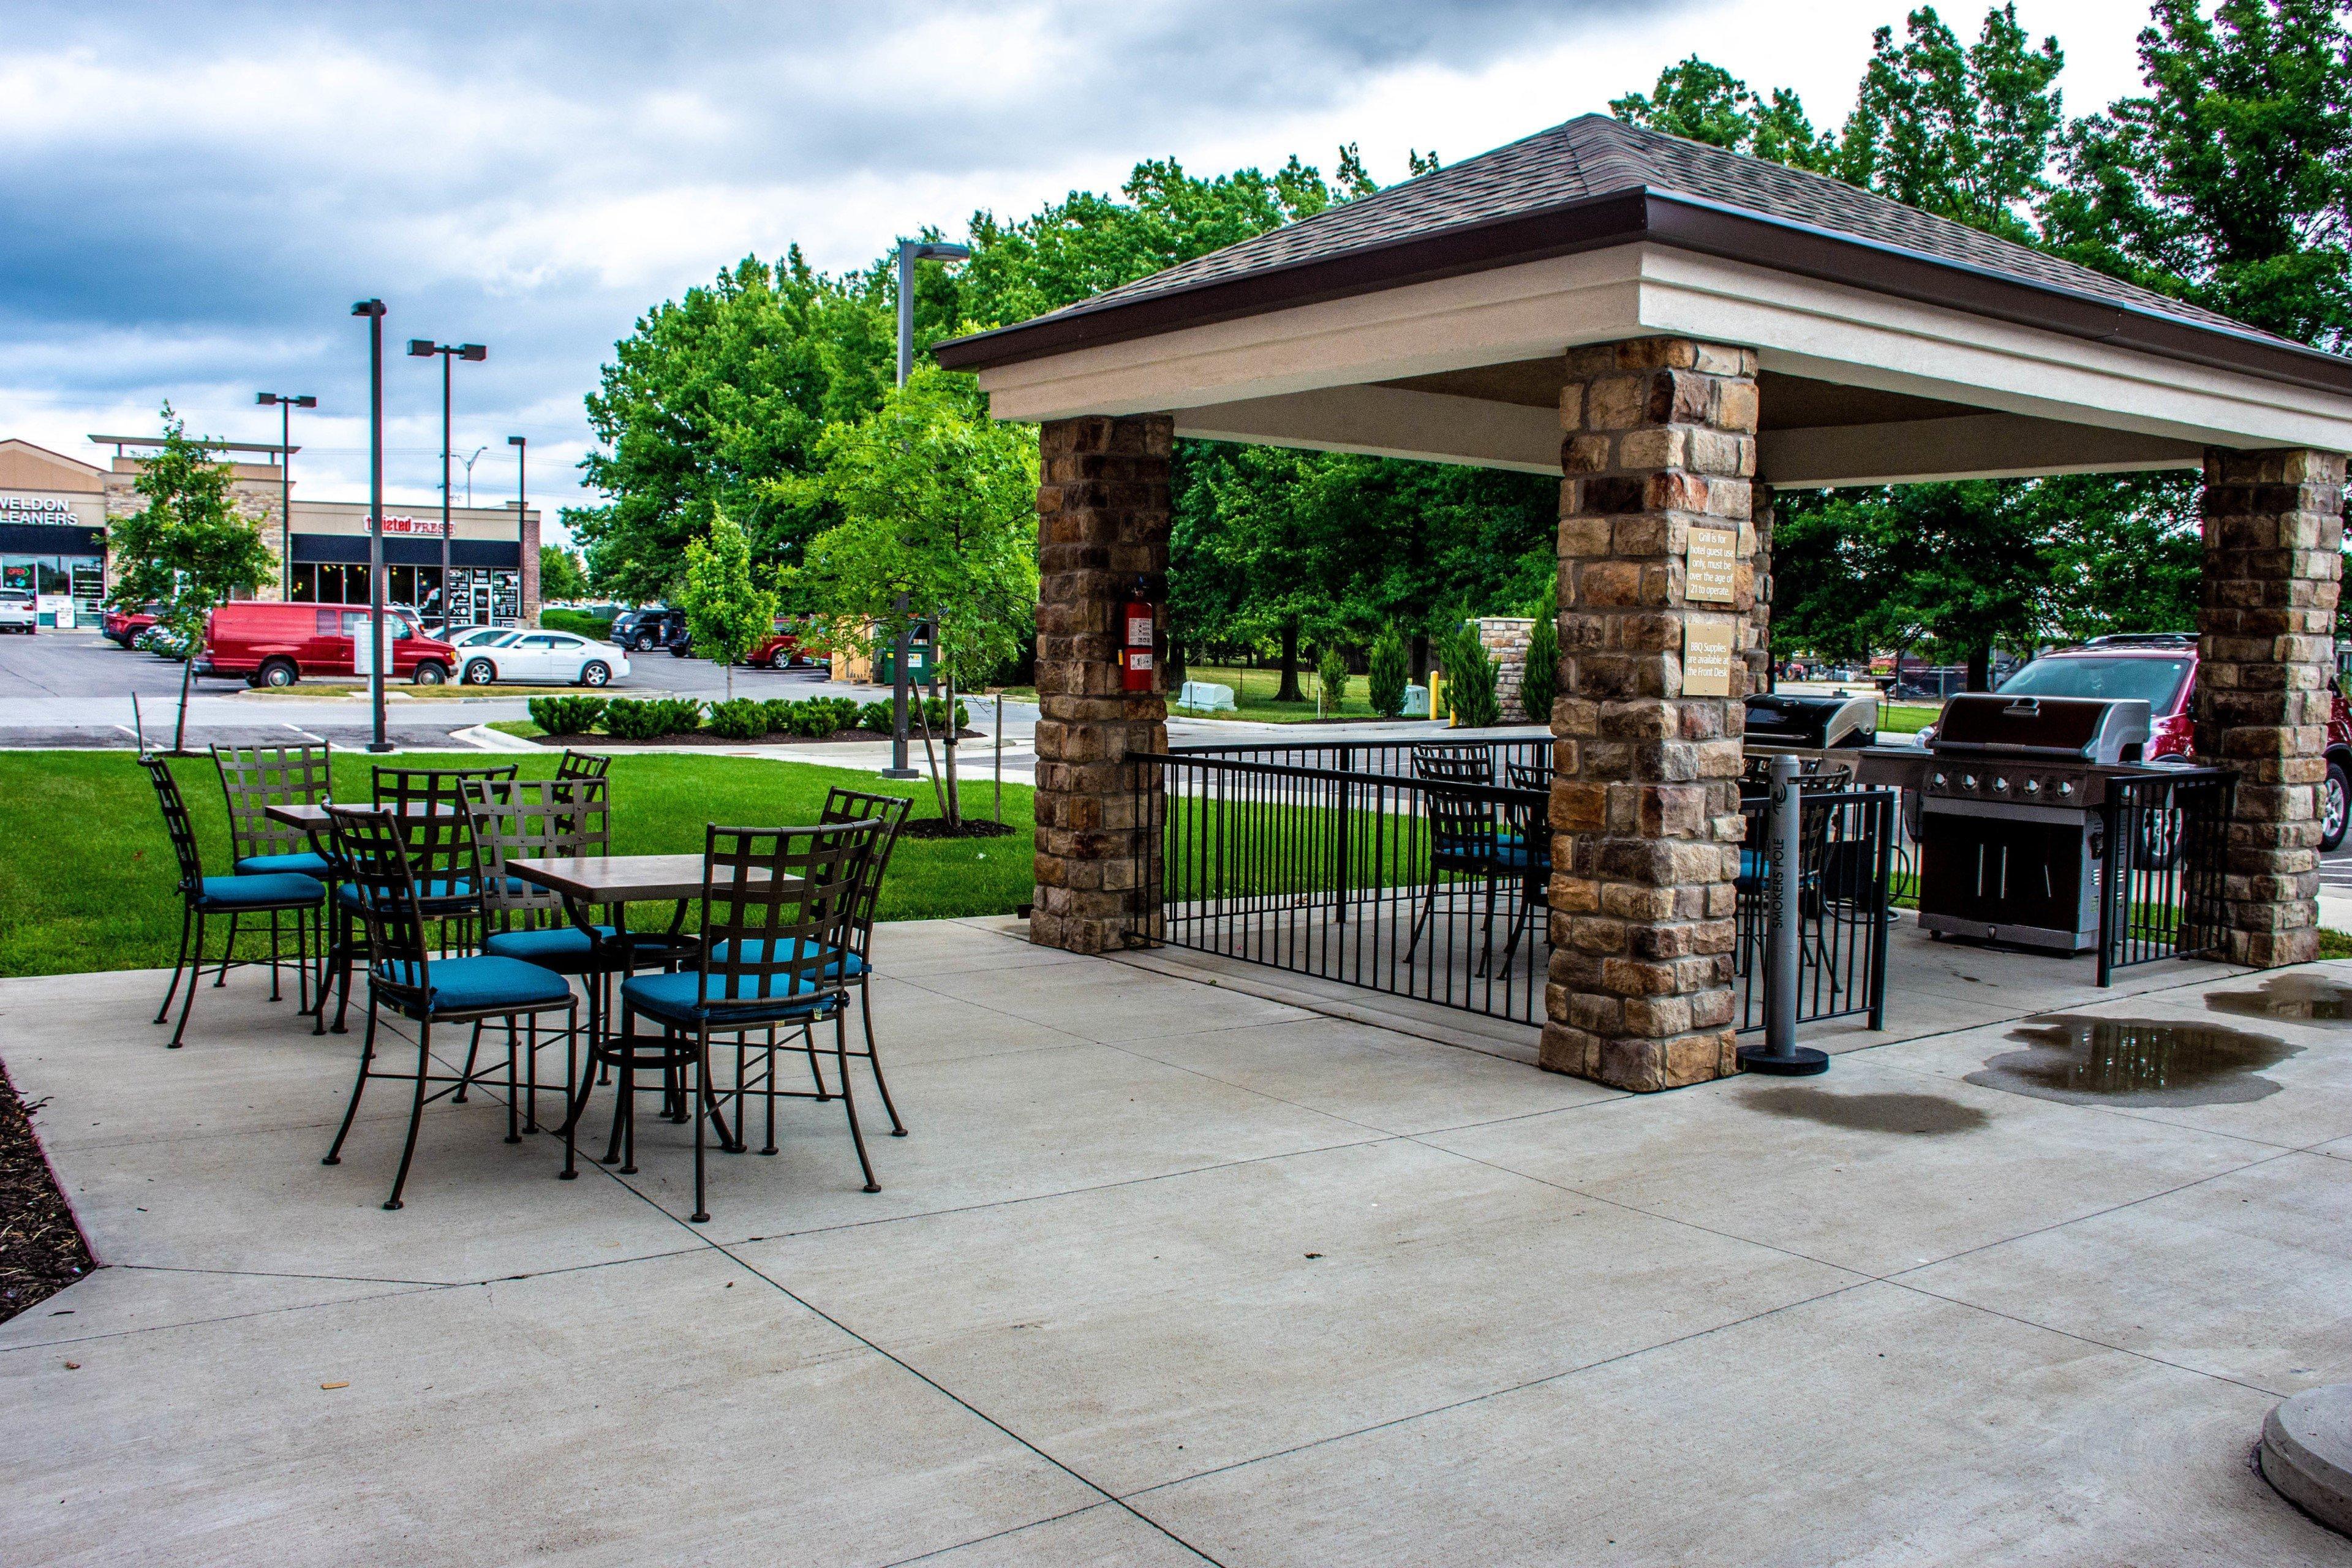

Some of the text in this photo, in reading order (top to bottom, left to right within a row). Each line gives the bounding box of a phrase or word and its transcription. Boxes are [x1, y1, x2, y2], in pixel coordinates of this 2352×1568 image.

[366, 516, 411, 532] tisted
[1698, 532, 1727, 544] Grill is for
[1691, 544, 1734, 558] hotel guest use
[1692, 558, 1732, 570] only, must be
[1703, 571, 1713, 581] the
[1714, 575, 1725, 584] age
[1727, 573, 1733, 583] of
[1691, 584, 1730, 598] 21 to operate.
[1691, 642, 1727, 654] BBQ Supplies
[1697, 655, 1722, 665] available
[1687, 666, 1727, 677] the Front Desk
[1772, 839, 1784, 867] POLE
